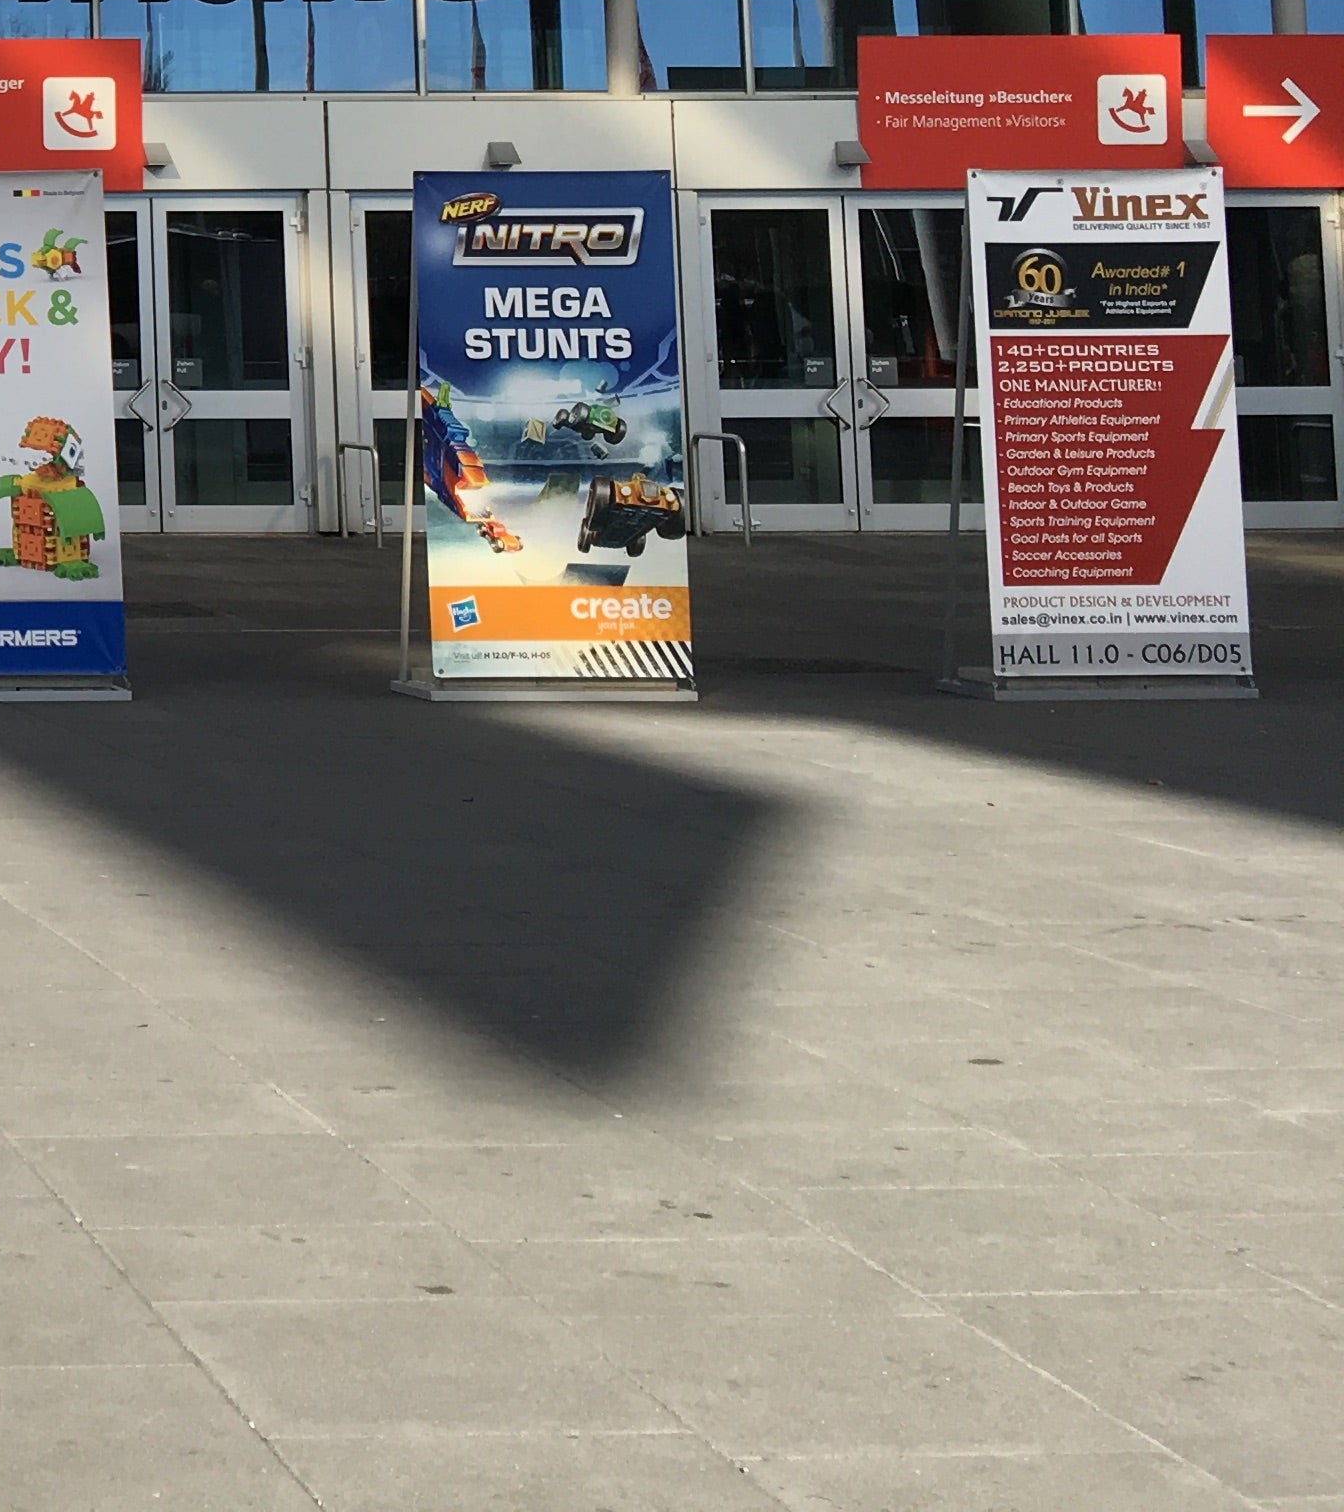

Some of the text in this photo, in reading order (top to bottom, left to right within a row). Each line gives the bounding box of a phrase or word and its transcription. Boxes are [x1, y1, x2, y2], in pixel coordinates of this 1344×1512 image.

[885, 90, 1073, 107] Messeleitung »Besucher«
[885, 115, 908, 128] Fair
[912, 115, 1001, 131] Management
[441, 198, 496, 221] NERF
[1071, 187, 1209, 222] Vinex
[1073, 223, 1124, 231] DELIVERING
[1126, 222, 1162, 230] QUALITY
[1193, 221, 1211, 229] 1957
[472, 223, 625, 252] NITRO
[1018, 256, 1062, 295] 60
[1176, 261, 1186, 278] 1
[47, 289, 79, 326] &
[484, 287, 612, 319] MEGA
[464, 327, 633, 360] STUNTS
[999, 378, 1162, 392] ONE MANUFACTURER!!
[1004, 398, 1123, 408] Educational Products
[1004, 414, 1161, 426] Primary Athletics Equipment
[1005, 431, 1149, 444] Primary Sports Equipment
[1006, 448, 1155, 459] Garden & Leisure Products
[1007, 465, 1147, 477] Outdoor Gym Equipment
[1008, 482, 1134, 494] Beach Toys & Products
[1009, 499, 1147, 510] Indoor & Outdoor Game
[1010, 515, 1155, 528] Sports Training Equipment
[1010, 533, 1142, 544] Goal Posts for all Sports
[1012, 550, 1122, 560] Soccer Accessories
[1013, 567, 1133, 579] Coaching Equipment
[570, 593, 673, 619] create
[1003, 595, 1231, 608] PRODUCT DESIGN & DEVELOPMENT
[1001, 612, 1238, 627] sales@vinex.co.in www.vinex.com
[1000, 643, 1242, 665] HALL 11.0 C06/D05
